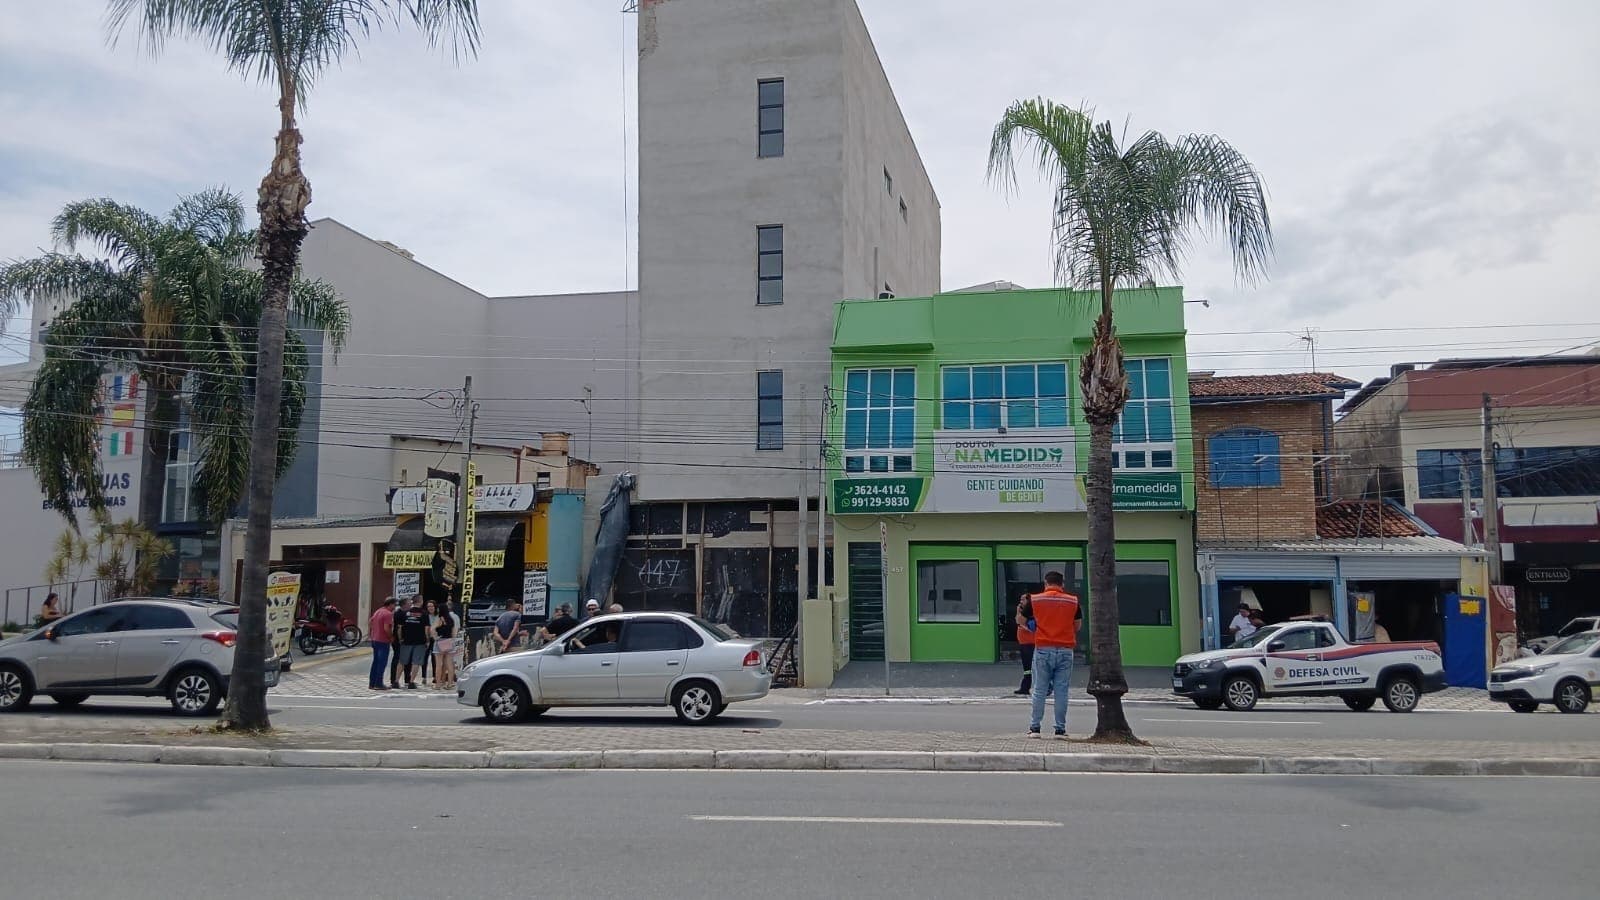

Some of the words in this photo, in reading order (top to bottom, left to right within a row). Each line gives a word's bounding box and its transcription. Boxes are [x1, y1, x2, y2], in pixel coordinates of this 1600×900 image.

[967, 480, 995, 490] GENTE
[998, 479, 1044, 490] CUIDANDO
[854, 485, 906, 495] 3624-4142
[1006, 491, 1016, 501] DE
[1017, 491, 1043, 501] GENTE
[852, 497, 910, 507] 99129-9830
[639, 559, 680, 586] 447
[1289, 667, 1330, 678] DEFESA
[1332, 666, 1361, 676] CIVIL
